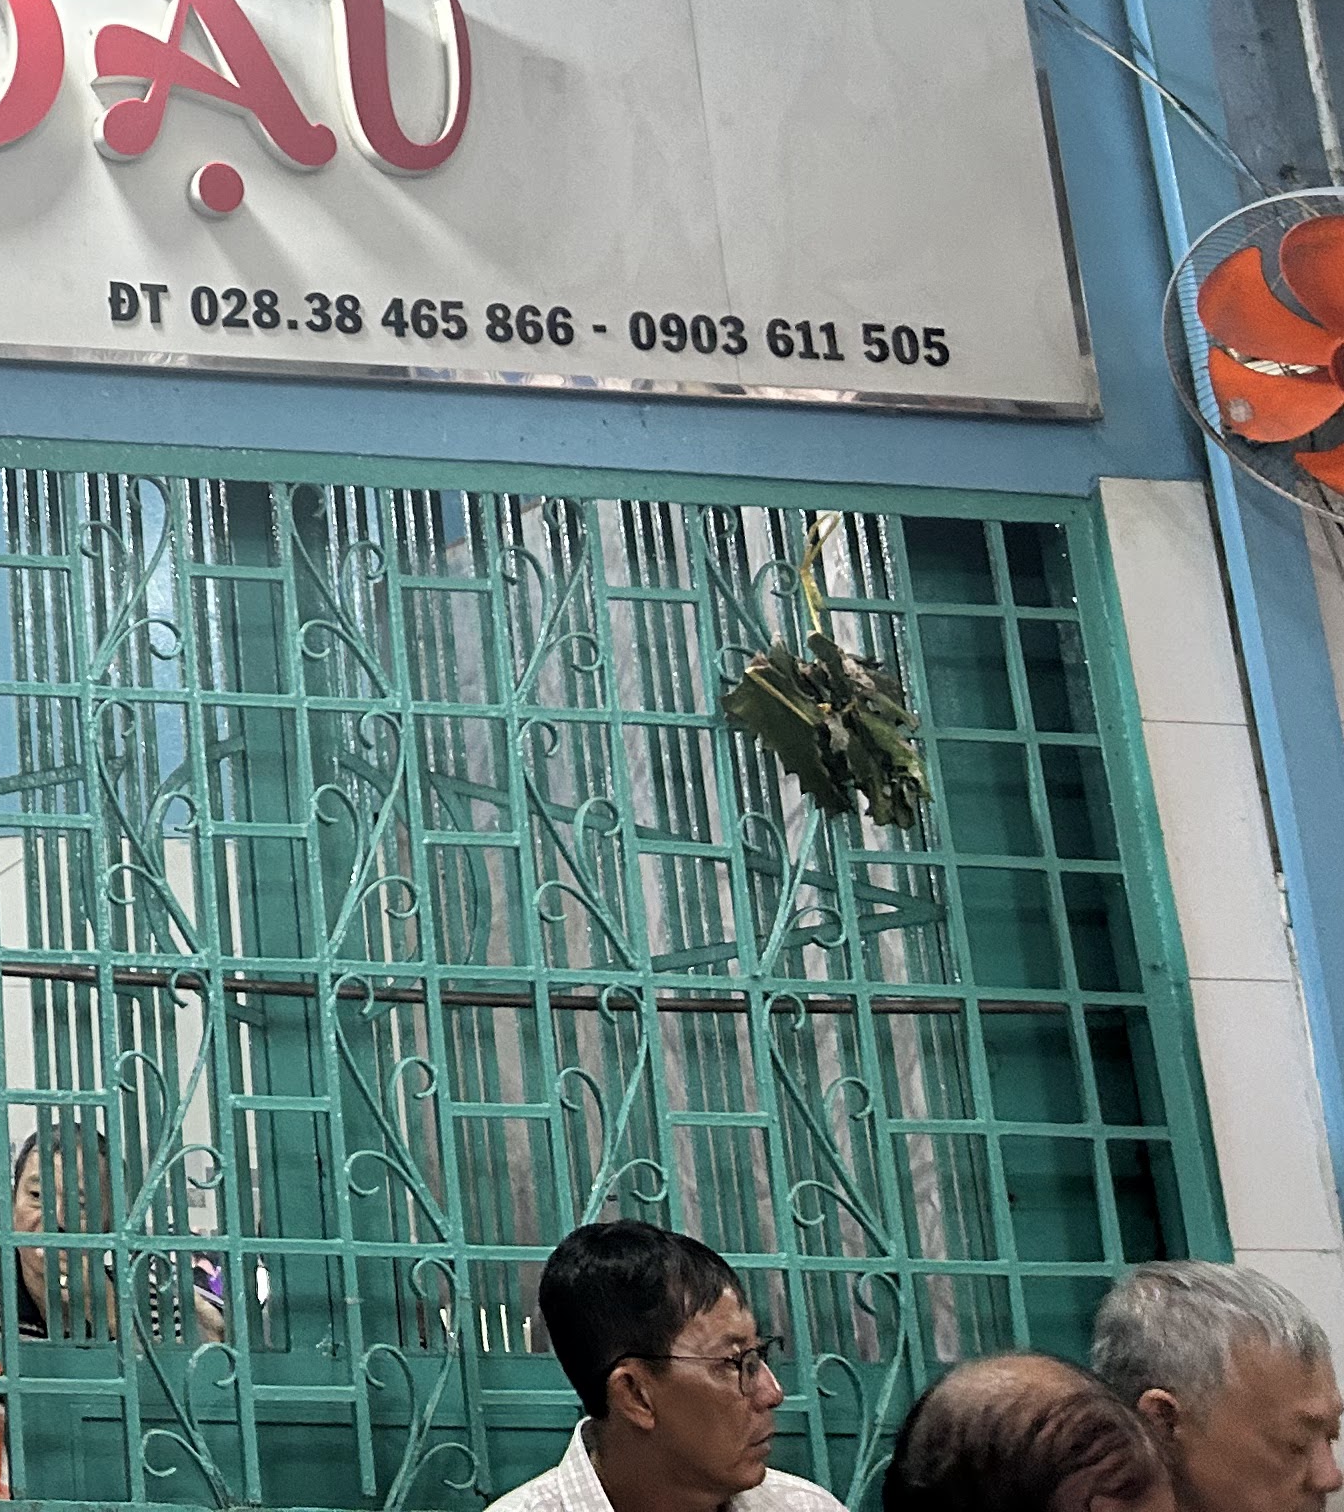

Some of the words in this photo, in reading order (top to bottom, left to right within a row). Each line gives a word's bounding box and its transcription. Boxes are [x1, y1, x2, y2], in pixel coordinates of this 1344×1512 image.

[108, 281, 168, 323] ĐT
[191, 286, 363, 334] 028.38
[381, 298, 468, 340] 465
[486, 303, 574, 345] 866
[629, 311, 748, 356] 0903
[766, 319, 845, 361] 611
[862, 323, 950, 367] 505
